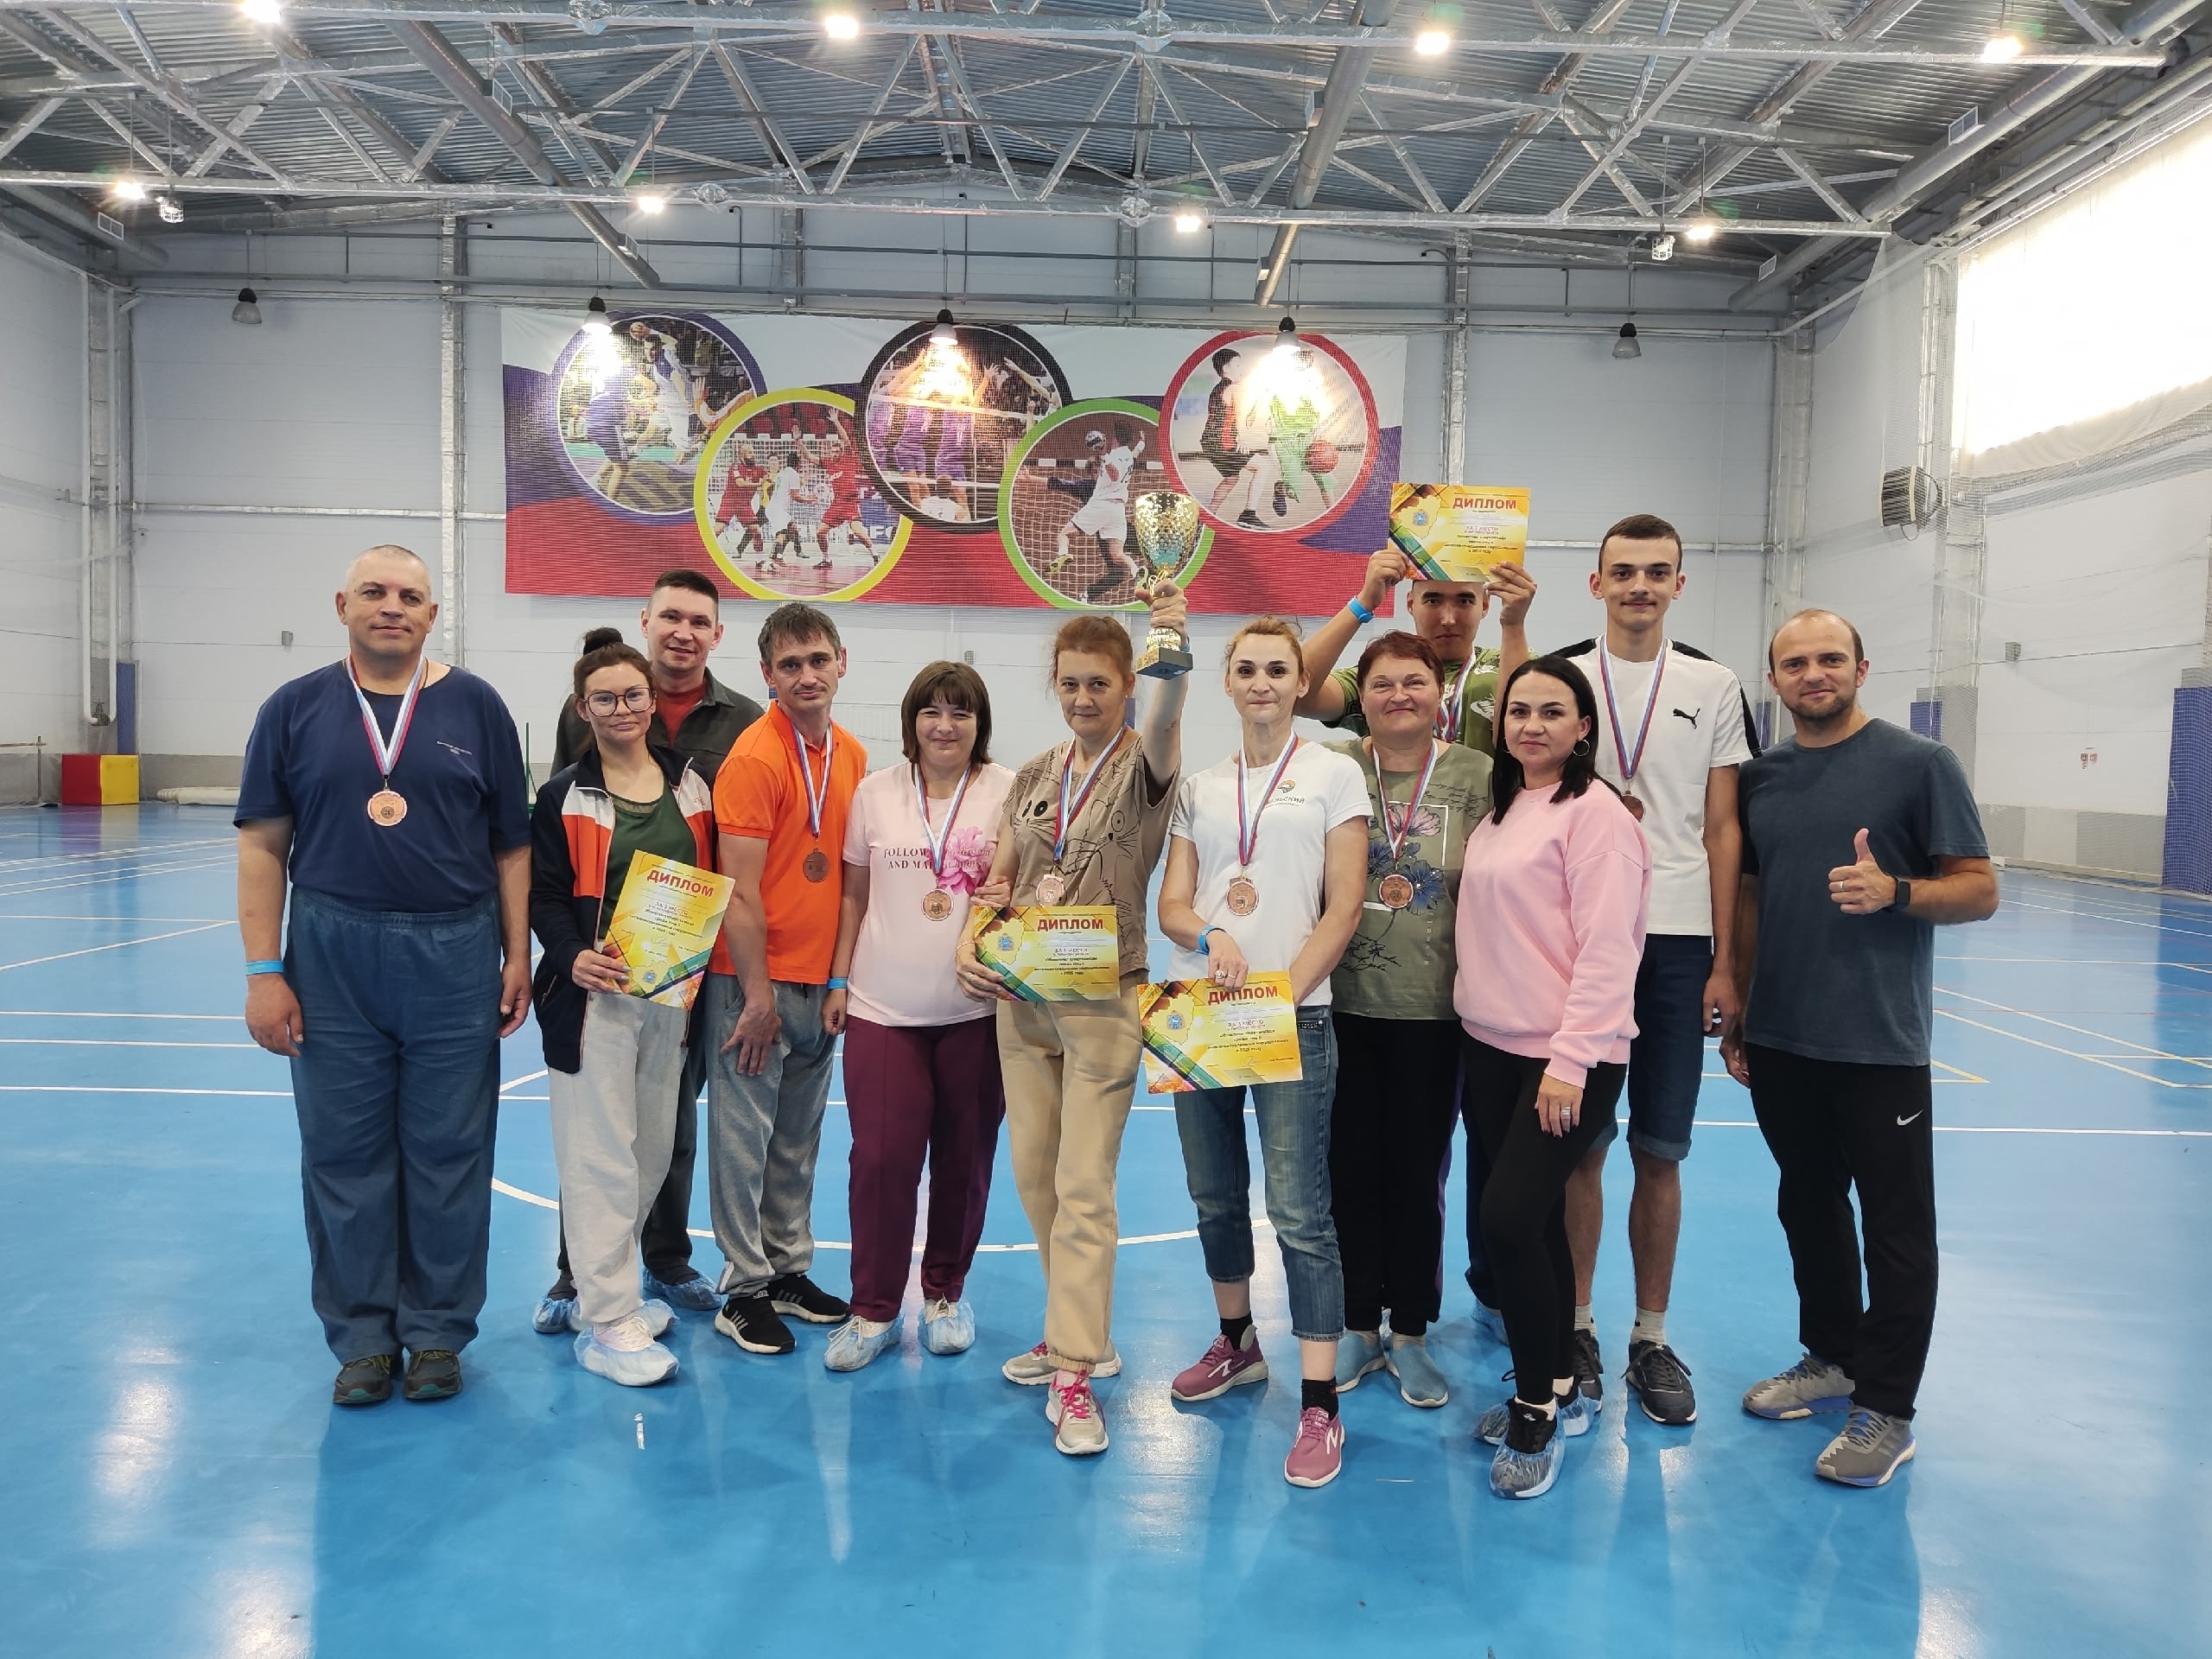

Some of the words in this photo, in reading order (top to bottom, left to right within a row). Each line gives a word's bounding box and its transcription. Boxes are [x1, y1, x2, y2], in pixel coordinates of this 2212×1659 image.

[1452, 497, 1516, 510] ДИПЛОМ
[884, 848, 928, 858] FOLLOW
[888, 860, 908, 870] AND
[646, 869, 715, 897] ДИПЛОМ
[1037, 918, 1103, 932] ДИПЛОМ
[1208, 986, 1278, 1007] ДИПЛОМ
